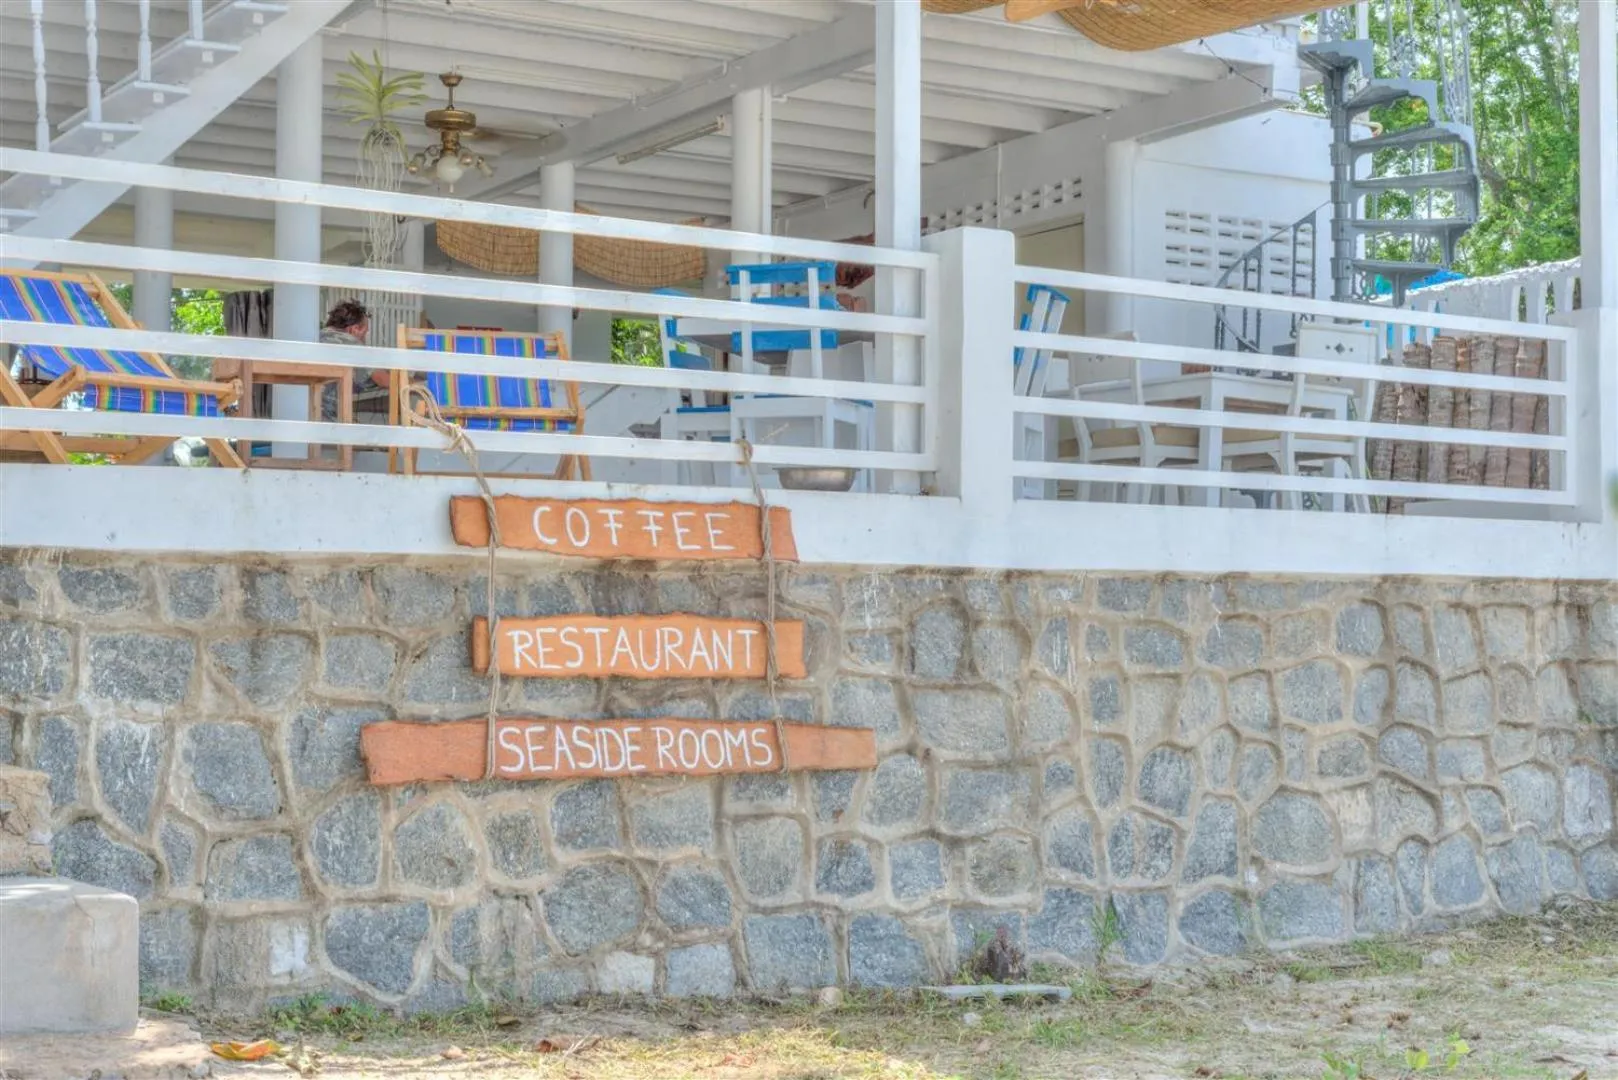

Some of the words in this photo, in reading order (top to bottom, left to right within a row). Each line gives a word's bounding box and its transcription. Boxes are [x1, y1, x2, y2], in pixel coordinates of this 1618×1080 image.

[533, 505, 736, 551] COFFEE
[506, 626, 760, 672] RESTAURANT
[498, 726, 647, 772] SEASIDE
[651, 727, 773, 770] ROOMS
